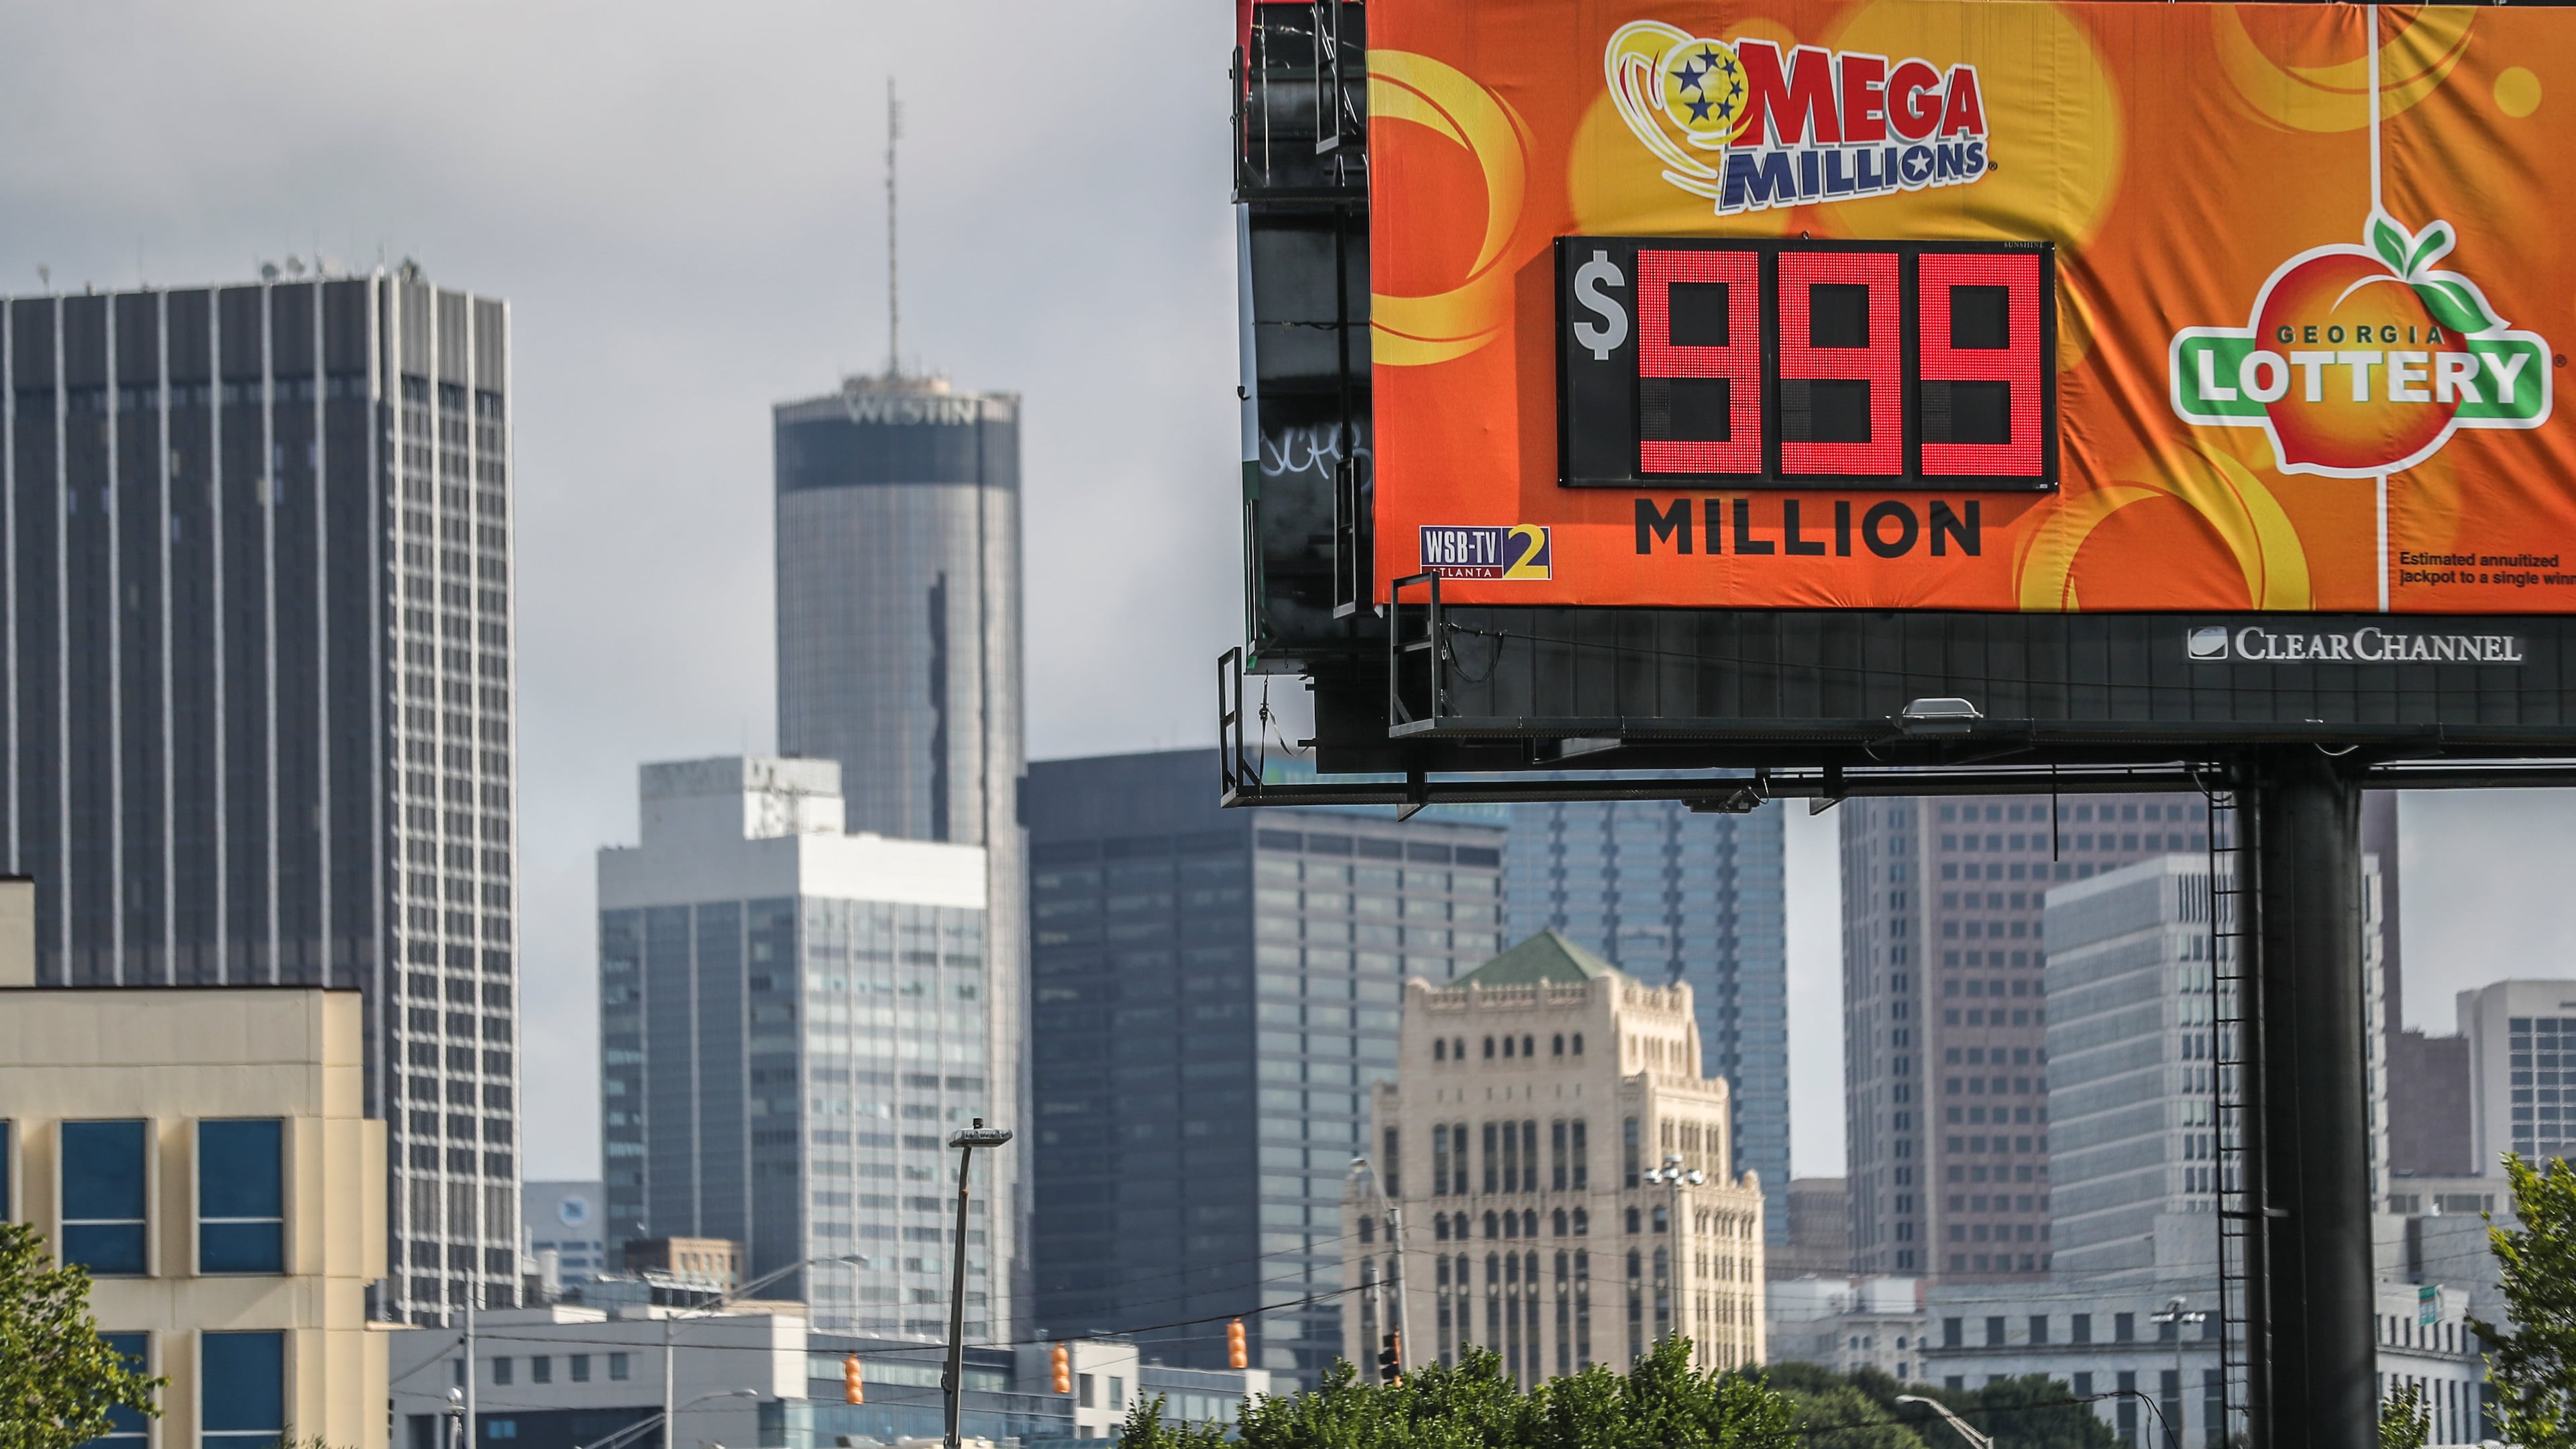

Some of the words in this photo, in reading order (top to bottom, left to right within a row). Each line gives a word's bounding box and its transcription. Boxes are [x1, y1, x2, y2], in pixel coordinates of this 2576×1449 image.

[1730, 42, 1984, 147] MEGA
[1722, 142, 1984, 206] MILLIONS
[2276, 325, 2445, 345] GEORGIA
[2198, 350, 2530, 404] LOTTERY
[843, 393, 976, 425] WESTIN
[1426, 531, 1497, 564] WSB-TV
[1503, 523, 1549, 579] 2
[1634, 498, 1982, 558] MILLION
[2400, 551, 2475, 566] Estimated
[2480, 553, 2559, 568] annuitized
[2400, 569, 2456, 586] jackpot
[2460, 571, 2475, 584] to
[2479, 574, 2488, 584] a
[2493, 571, 2539, 588] single
